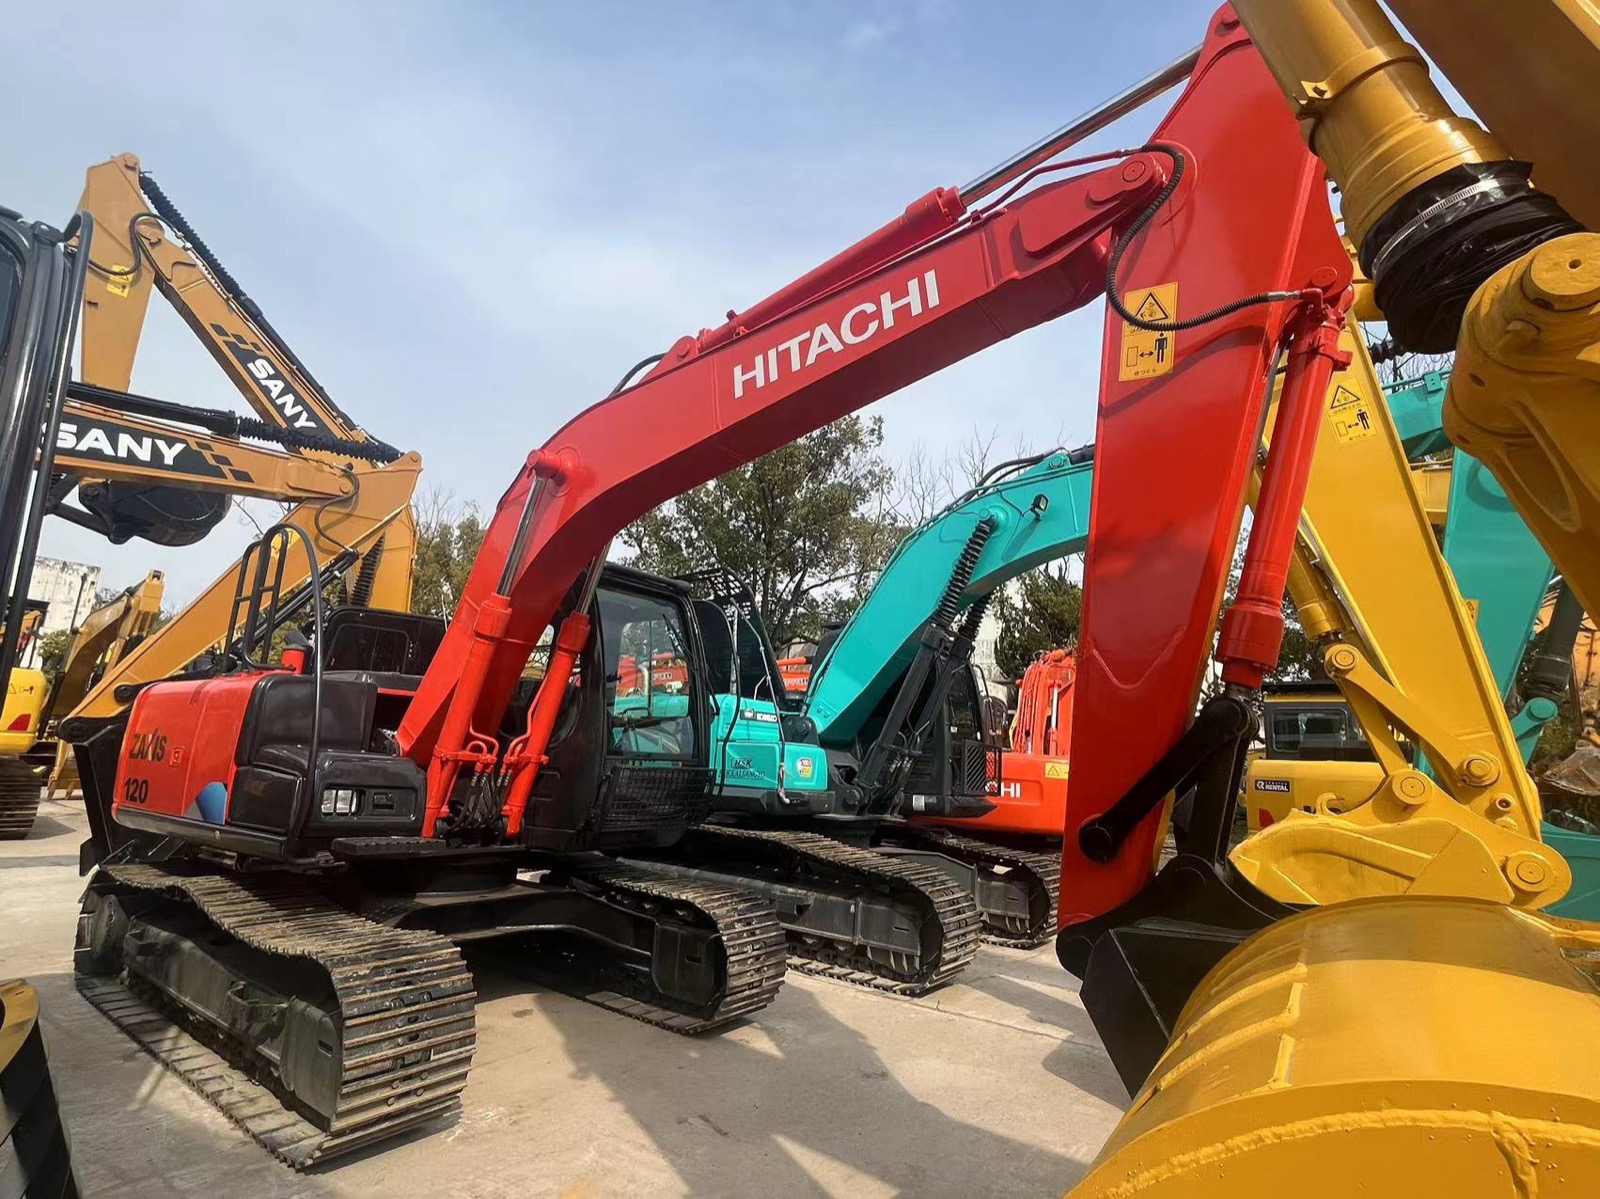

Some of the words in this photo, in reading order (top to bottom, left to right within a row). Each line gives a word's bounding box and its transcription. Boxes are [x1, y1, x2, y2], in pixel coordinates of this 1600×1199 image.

[733, 269, 940, 399] HITACHI
[247, 358, 317, 428] SANY
[36, 421, 187, 466] SANY
[129, 727, 167, 762] ZAXIS
[124, 777, 149, 804] 120
